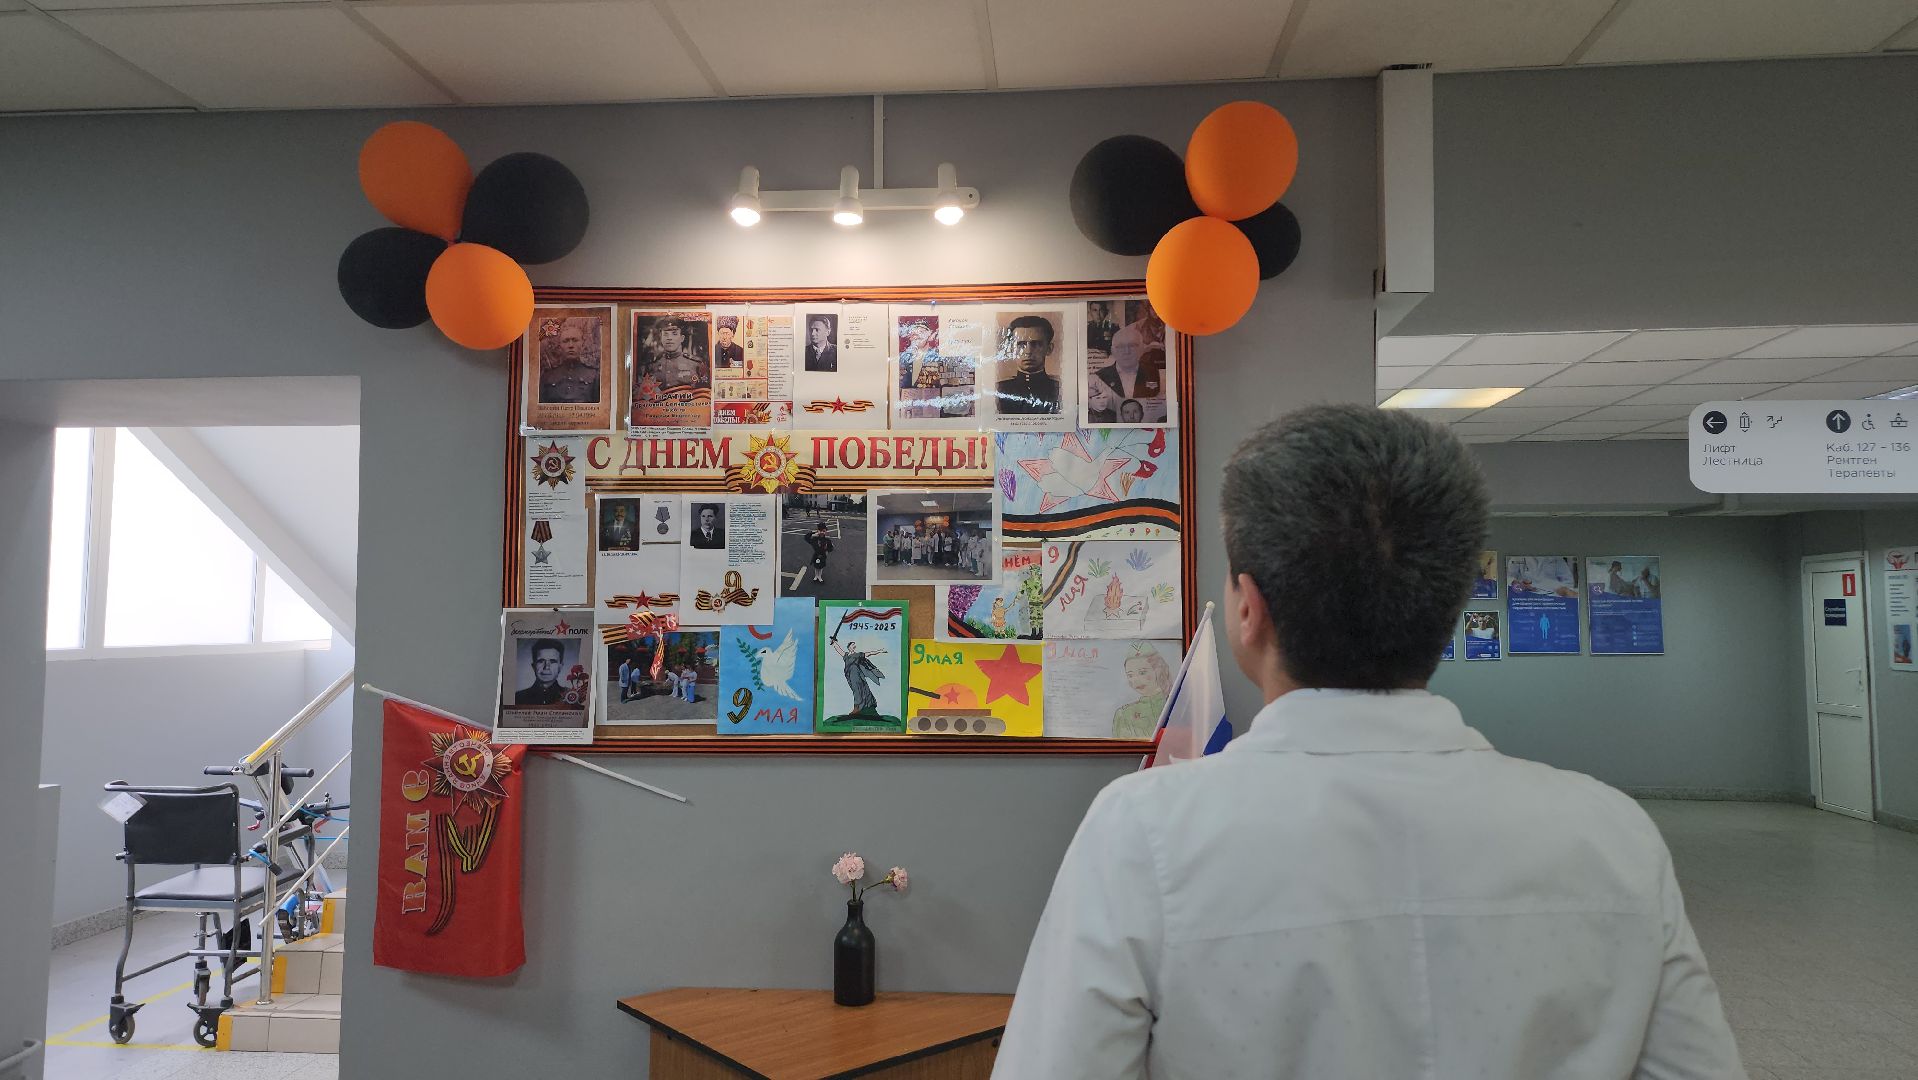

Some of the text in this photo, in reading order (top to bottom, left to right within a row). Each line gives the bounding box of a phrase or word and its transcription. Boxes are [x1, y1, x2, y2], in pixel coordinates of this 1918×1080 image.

[1703, 443, 1736, 455] Лифт
[1826, 442, 1853, 452] Каб.
[1857, 442, 1876, 452] 127
[1891, 442, 1911, 452] 136
[587, 436, 987, 476] С ДНЕМ ПОБЕДЫ!
[1702, 456, 1763, 467] Лестница
[1827, 455, 1877, 465] Рентген
[1829, 468, 1896, 479] Терапевты
[848, 622, 896, 631] 1945-2025
[727, 687, 753, 724] 9
